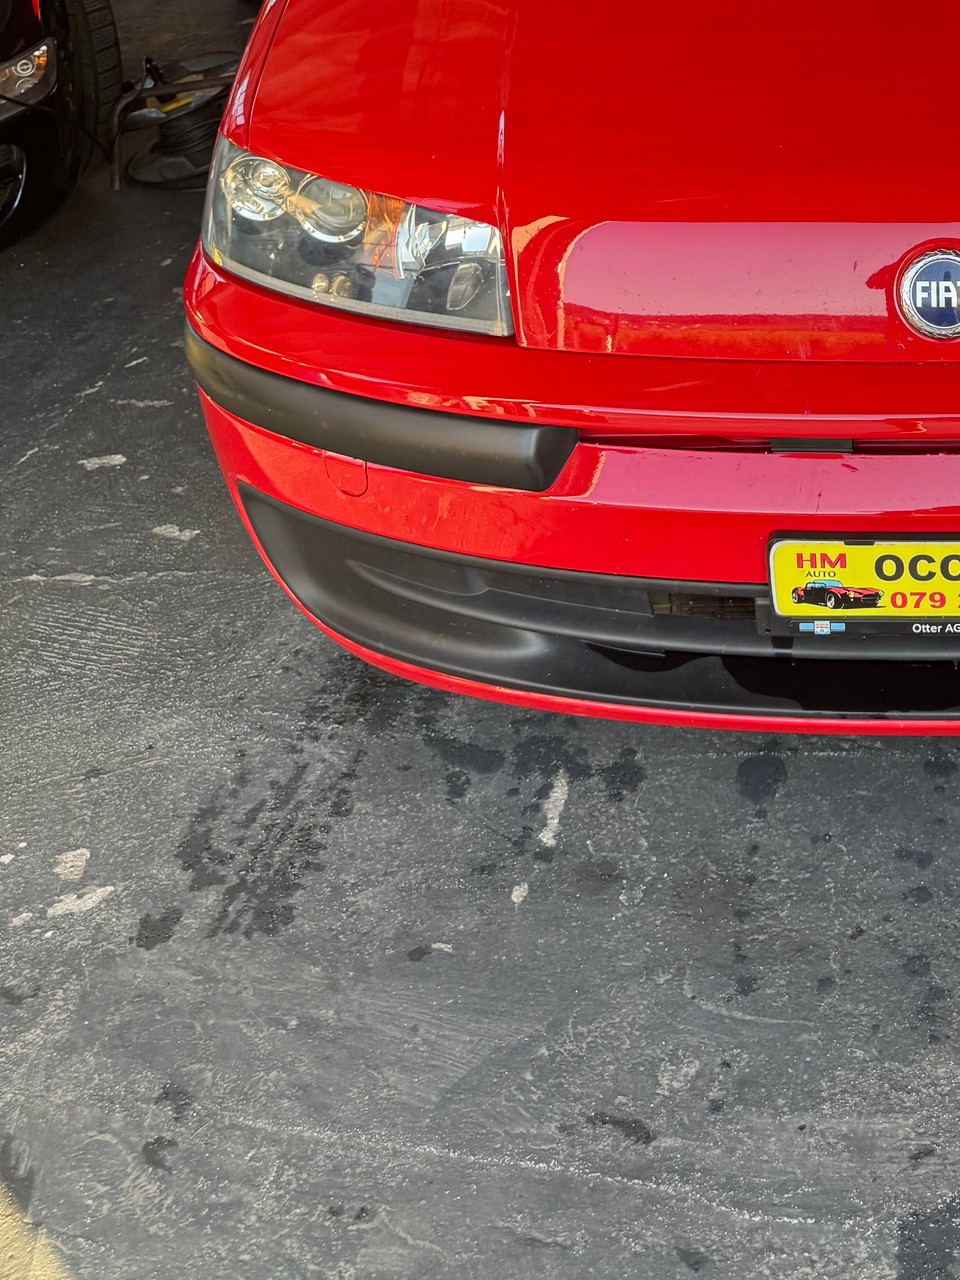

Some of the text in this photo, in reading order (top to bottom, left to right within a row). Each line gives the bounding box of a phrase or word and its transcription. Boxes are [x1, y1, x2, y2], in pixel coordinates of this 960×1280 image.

[796, 553, 847, 569] HM
[890, 591, 947, 609] 079
[912, 623, 943, 634] Otter
